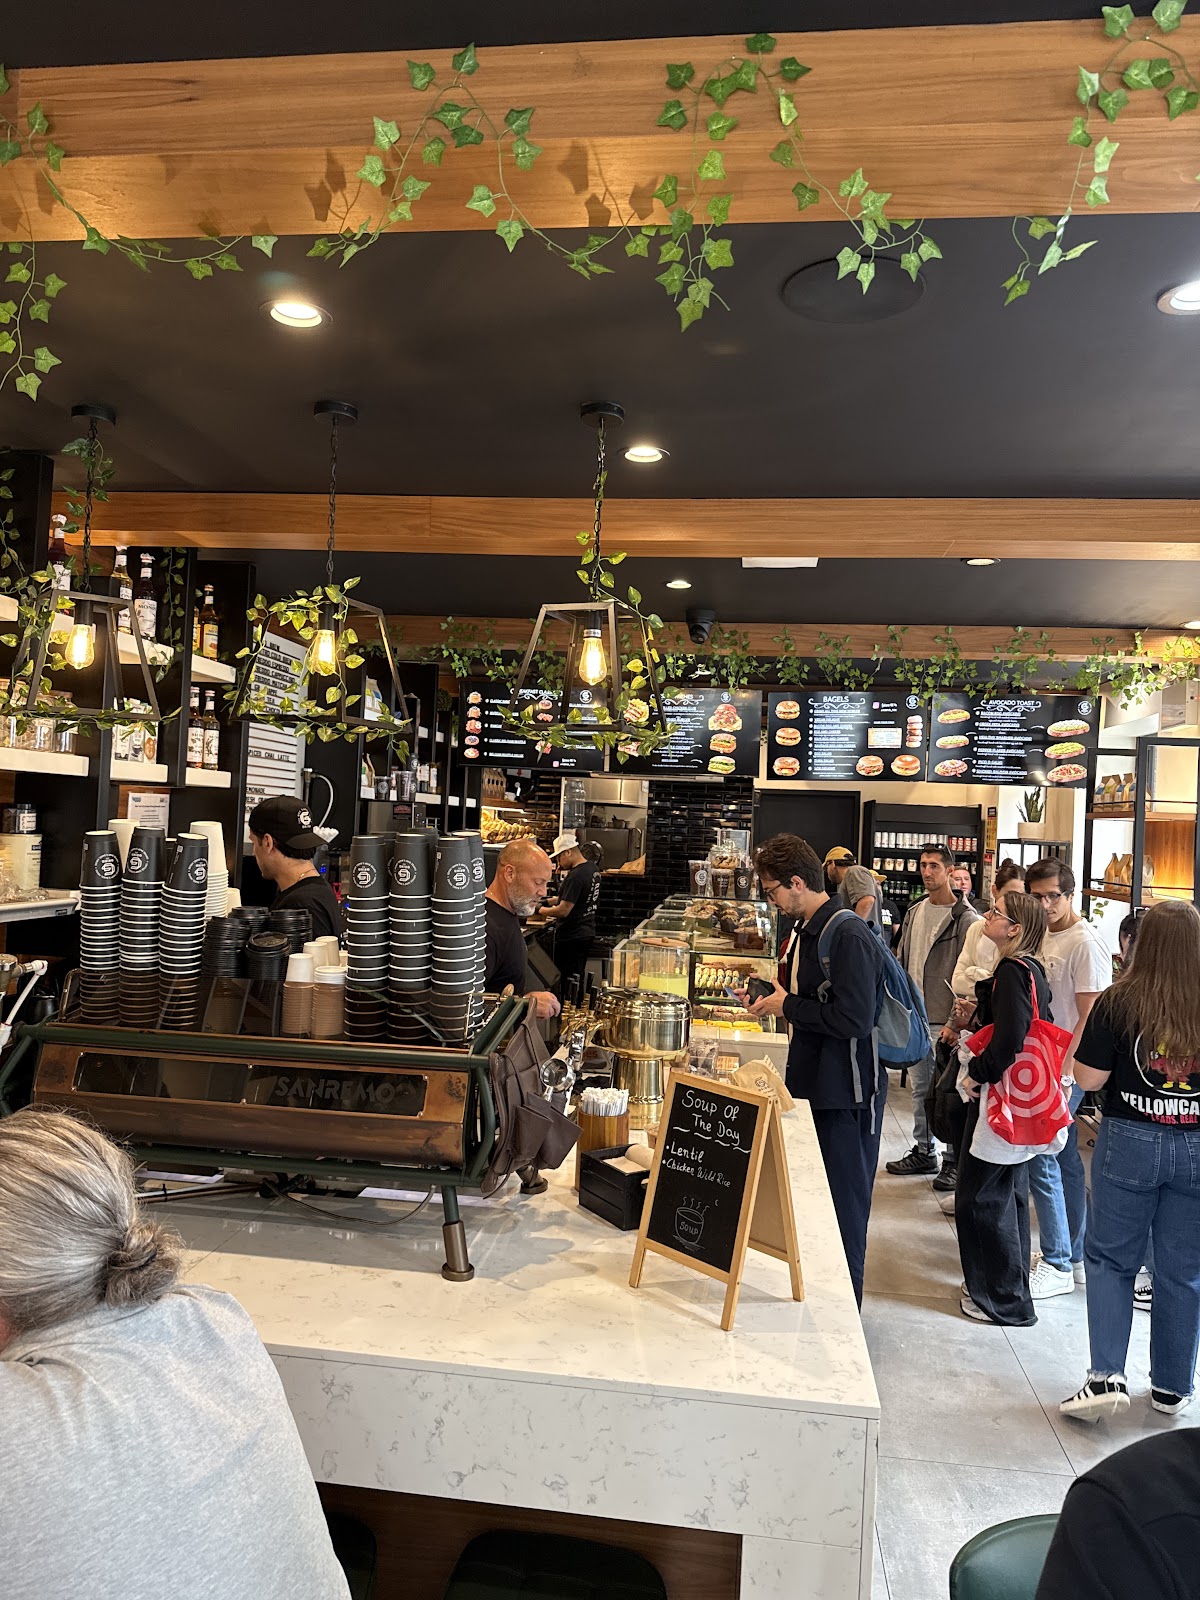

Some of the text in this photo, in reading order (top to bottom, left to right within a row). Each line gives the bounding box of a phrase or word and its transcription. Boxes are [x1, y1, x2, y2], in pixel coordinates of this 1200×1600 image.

[275, 1076, 396, 1104] SANREMO
[682, 1090, 739, 1121] Soup Of
[1180, 1115, 1198, 1124] REAL
[692, 1113, 740, 1146] The Day
[670, 1141, 704, 1163] Lentil
[666, 1158, 731, 1188] Chicken Wild Rice
